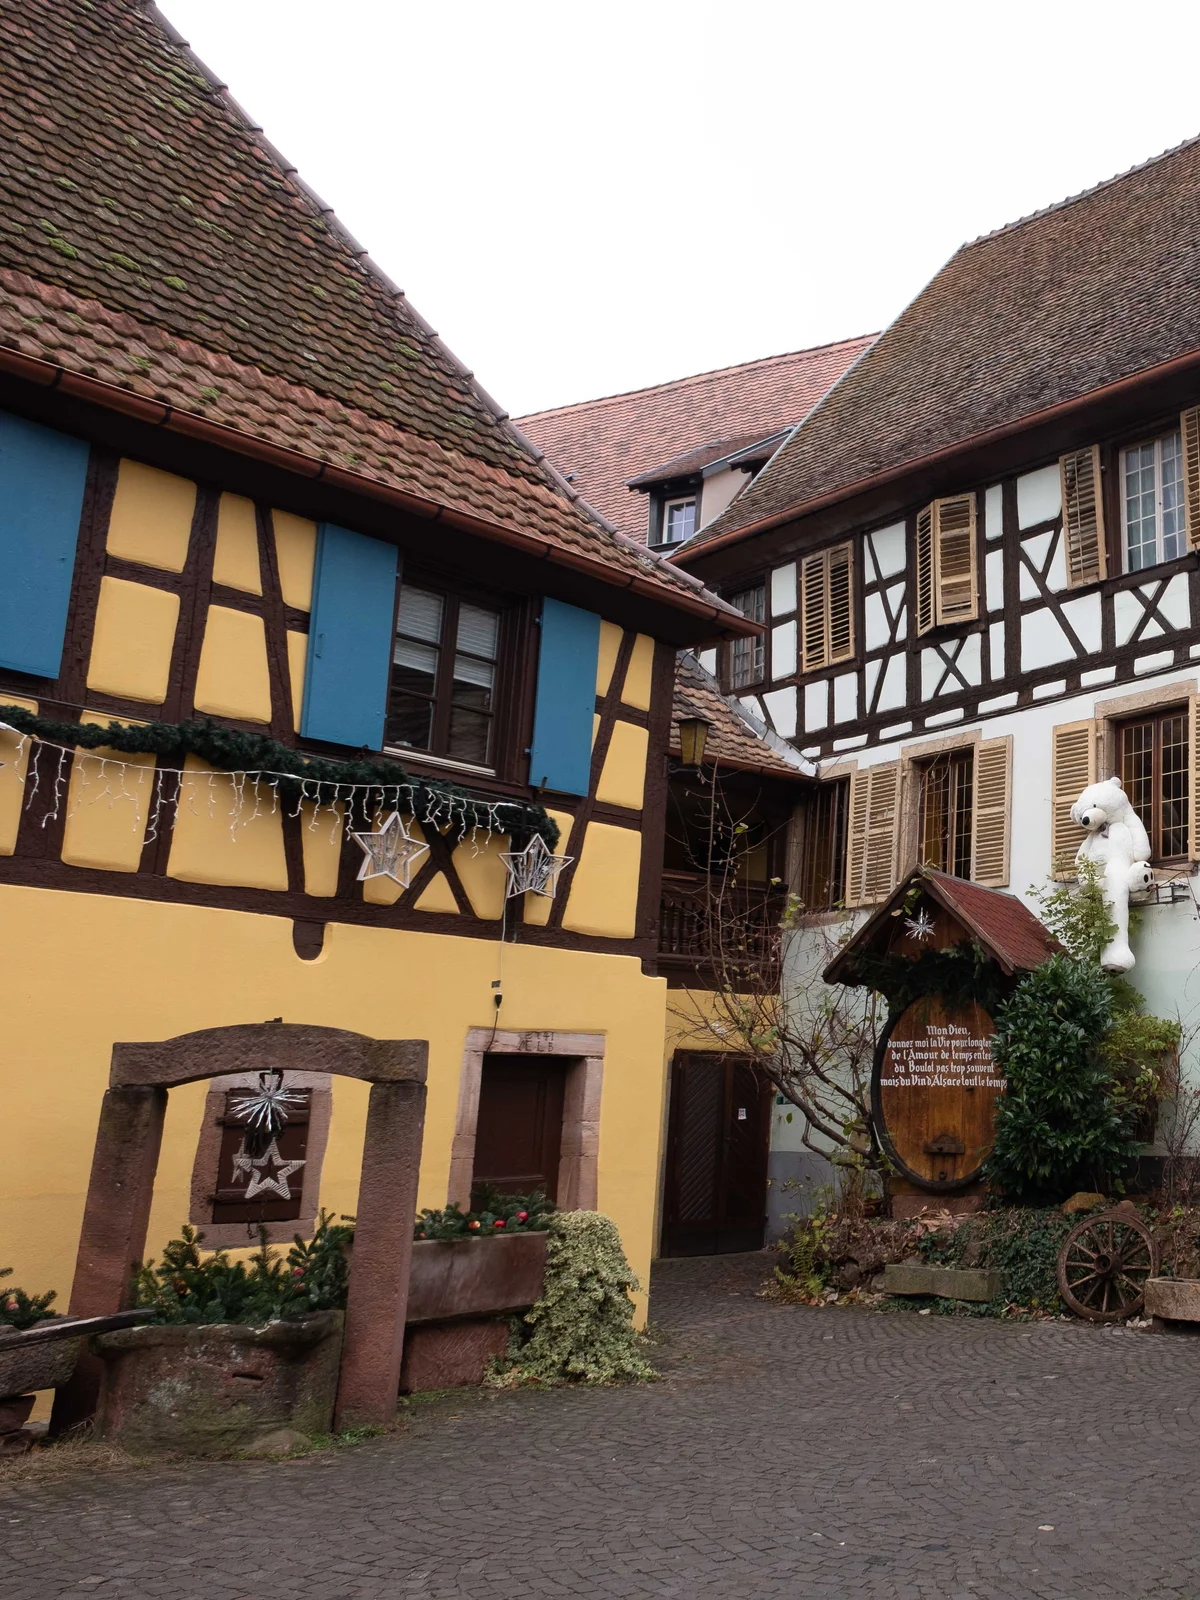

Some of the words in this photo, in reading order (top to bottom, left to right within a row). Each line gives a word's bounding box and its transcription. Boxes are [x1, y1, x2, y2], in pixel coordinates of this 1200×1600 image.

[926, 1025, 948, 1035] Mon
[887, 1038, 913, 1048] donnez
[915, 1037, 929, 1048] moi
[951, 1039, 967, 1051] pour
[891, 1050, 901, 1060] de
[903, 1048, 938, 1060] l'Amour
[940, 1050, 950, 1060] de
[952, 1050, 973, 1062] temps
[973, 1052, 982, 1060] en
[894, 1063, 905, 1073] du
[908, 1060, 934, 1073] Boulot
[936, 1064, 949, 1074] pas
[950, 1062, 966, 1075] trop
[967, 1061, 994, 1074] souvent
[880, 1075, 899, 1087] mais
[899, 1076, 911, 1087] du
[911, 1074, 926, 1086] Vin
[961, 1075, 978, 1087] tout
[978, 1075, 985, 1087] le
[986, 1076, 1008, 1091] temps
